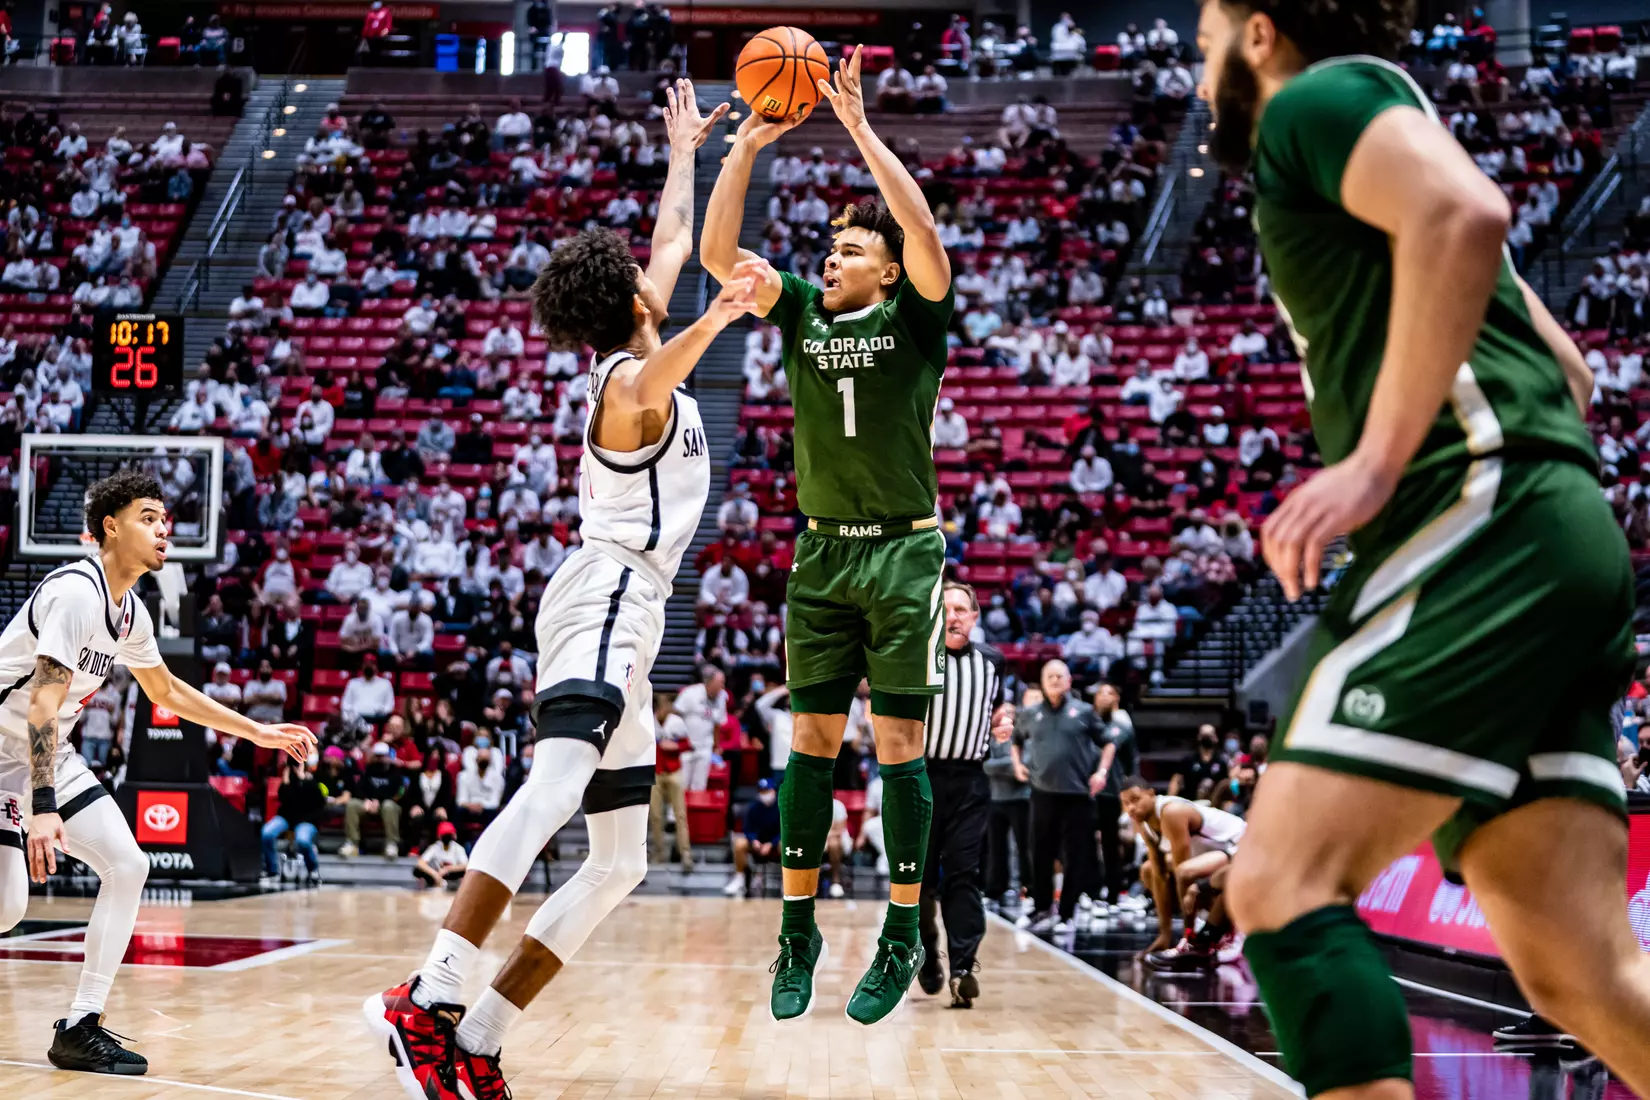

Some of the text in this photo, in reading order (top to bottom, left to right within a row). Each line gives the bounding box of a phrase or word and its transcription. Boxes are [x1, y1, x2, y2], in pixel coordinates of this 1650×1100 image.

[110, 320, 169, 346] 10:17
[803, 335, 895, 354] COLORADO
[110, 346, 158, 388] 26
[817, 352, 875, 370] STATE
[837, 377, 857, 437] 1
[839, 524, 882, 537] RAMS
[146, 727, 184, 740] TOYOTA
[142, 851, 194, 870] YOTA
